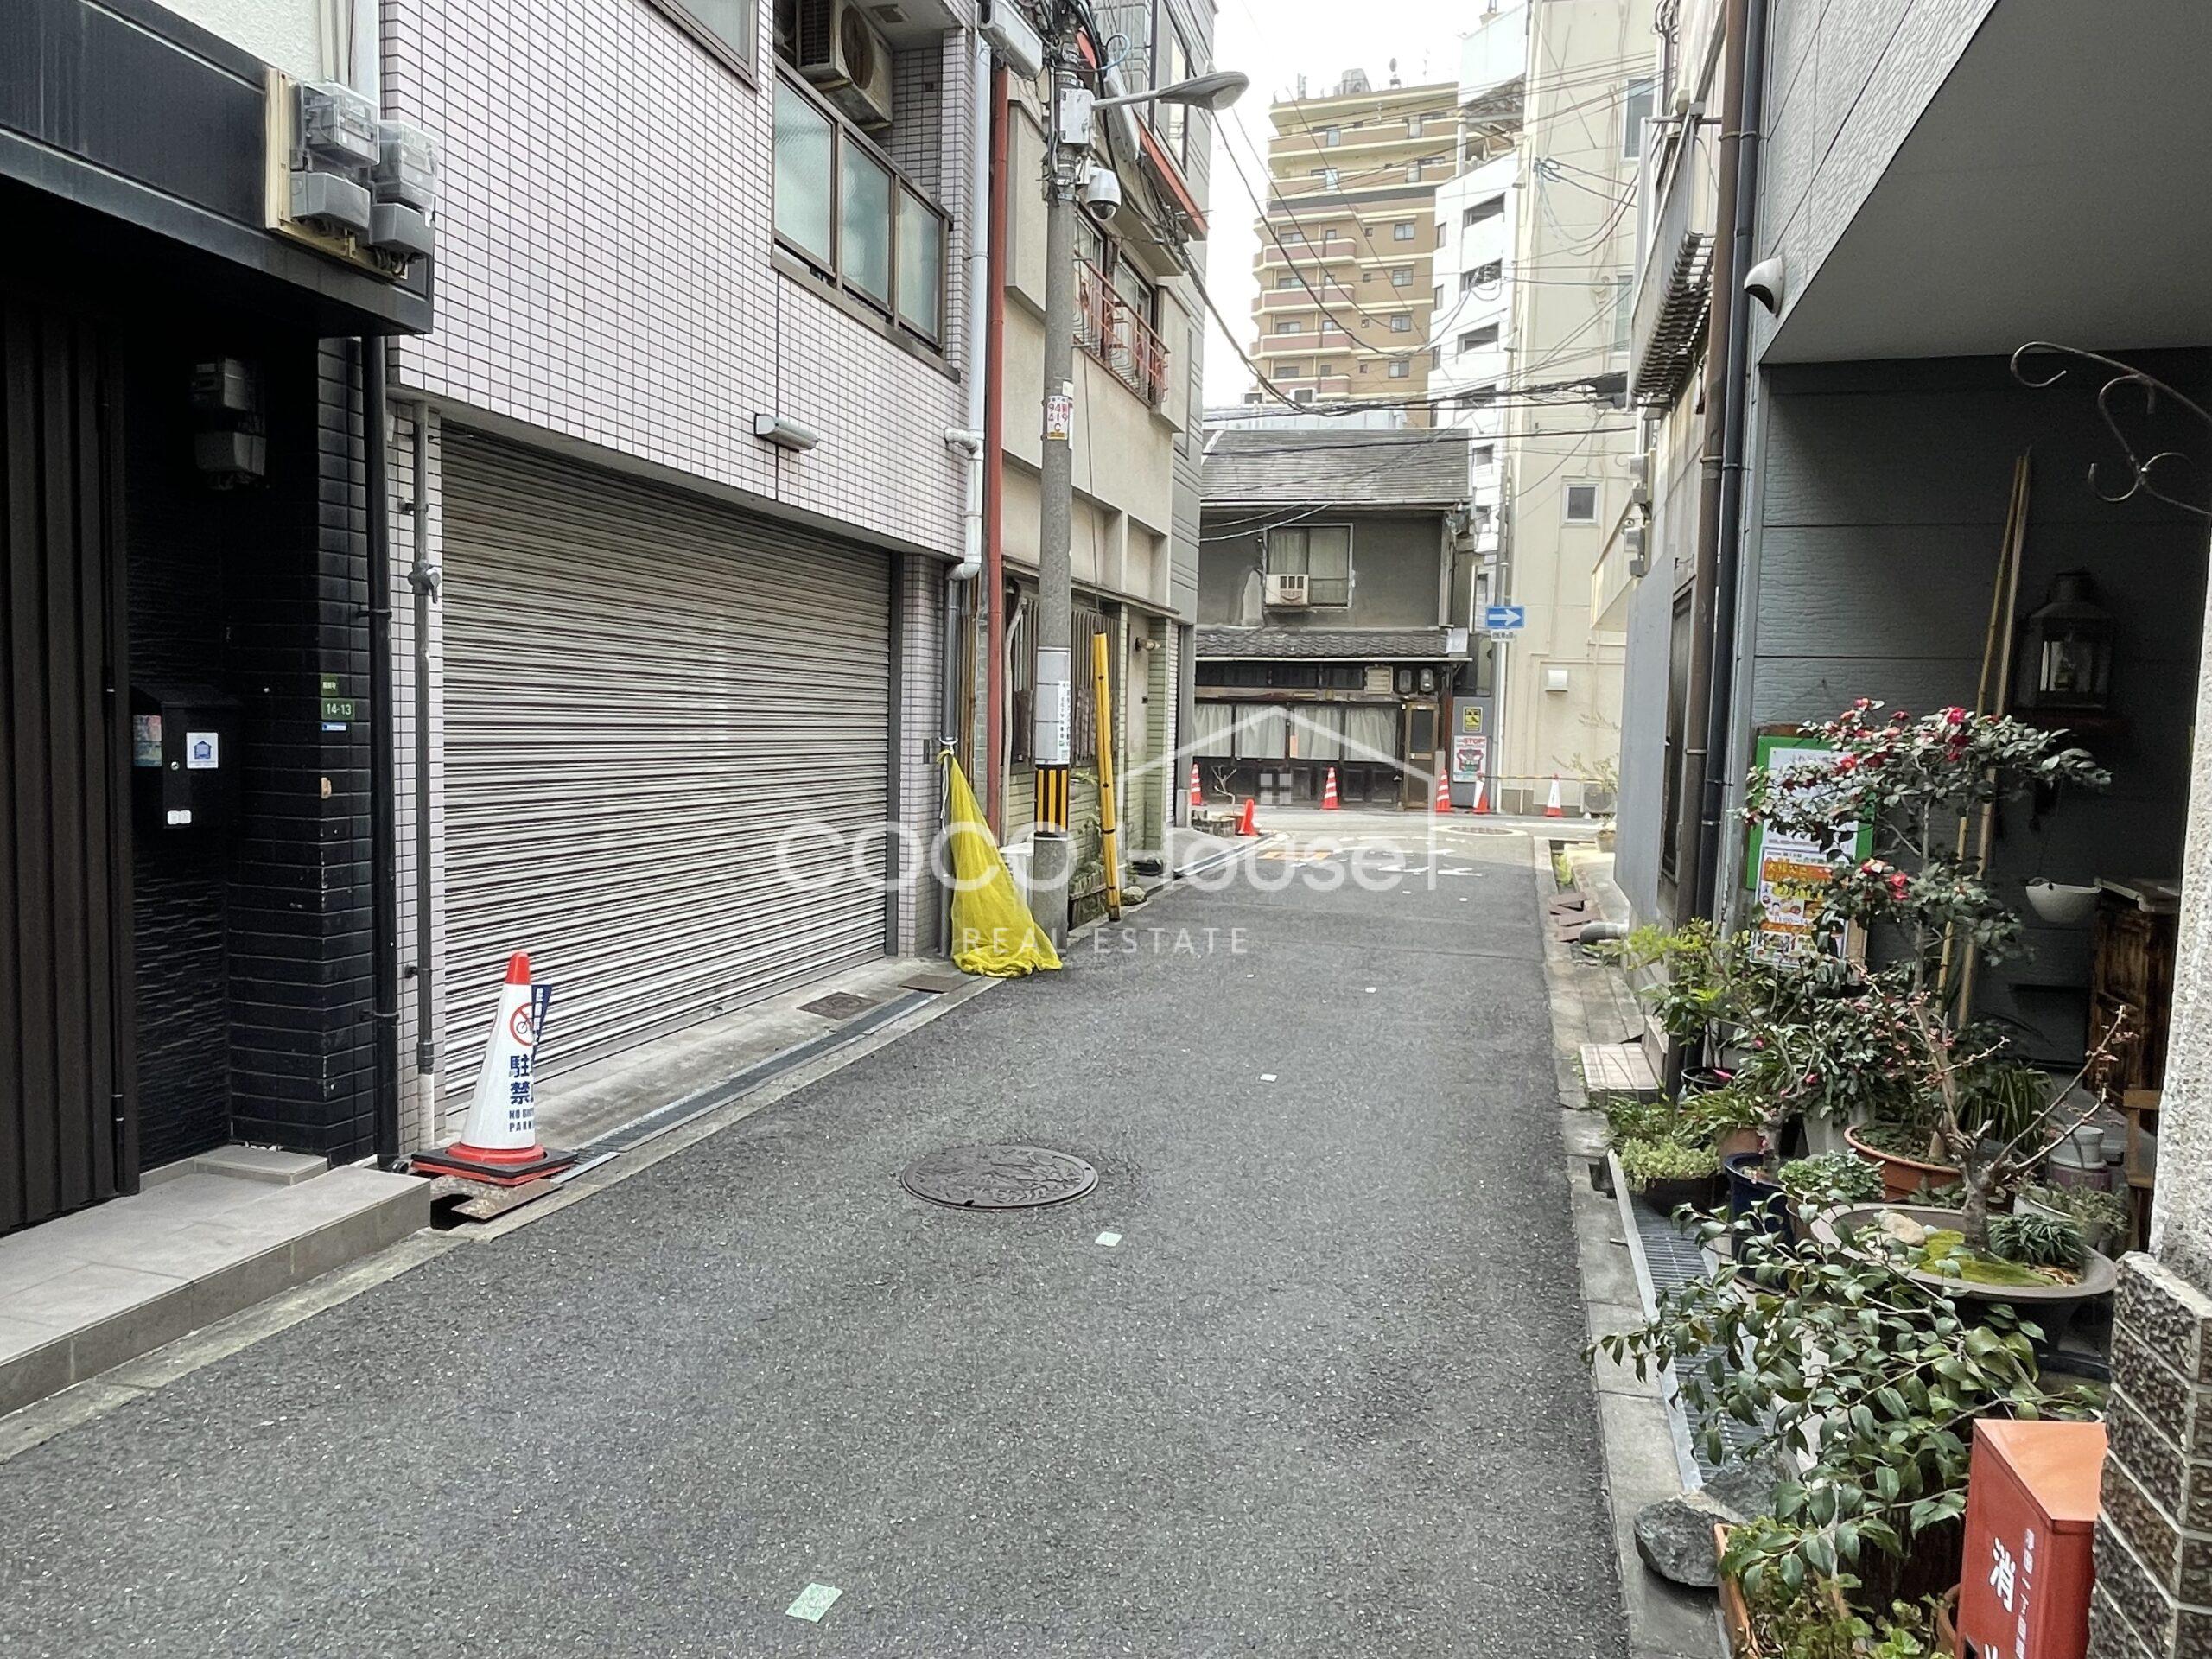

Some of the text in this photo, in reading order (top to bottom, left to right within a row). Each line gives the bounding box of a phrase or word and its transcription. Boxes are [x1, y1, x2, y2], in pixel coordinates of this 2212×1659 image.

[326, 702, 352, 715] 14-13
[509, 1053, 534, 1078] 駐
[509, 1080, 534, 1105] 禁
[509, 1109, 520, 1120] NO
